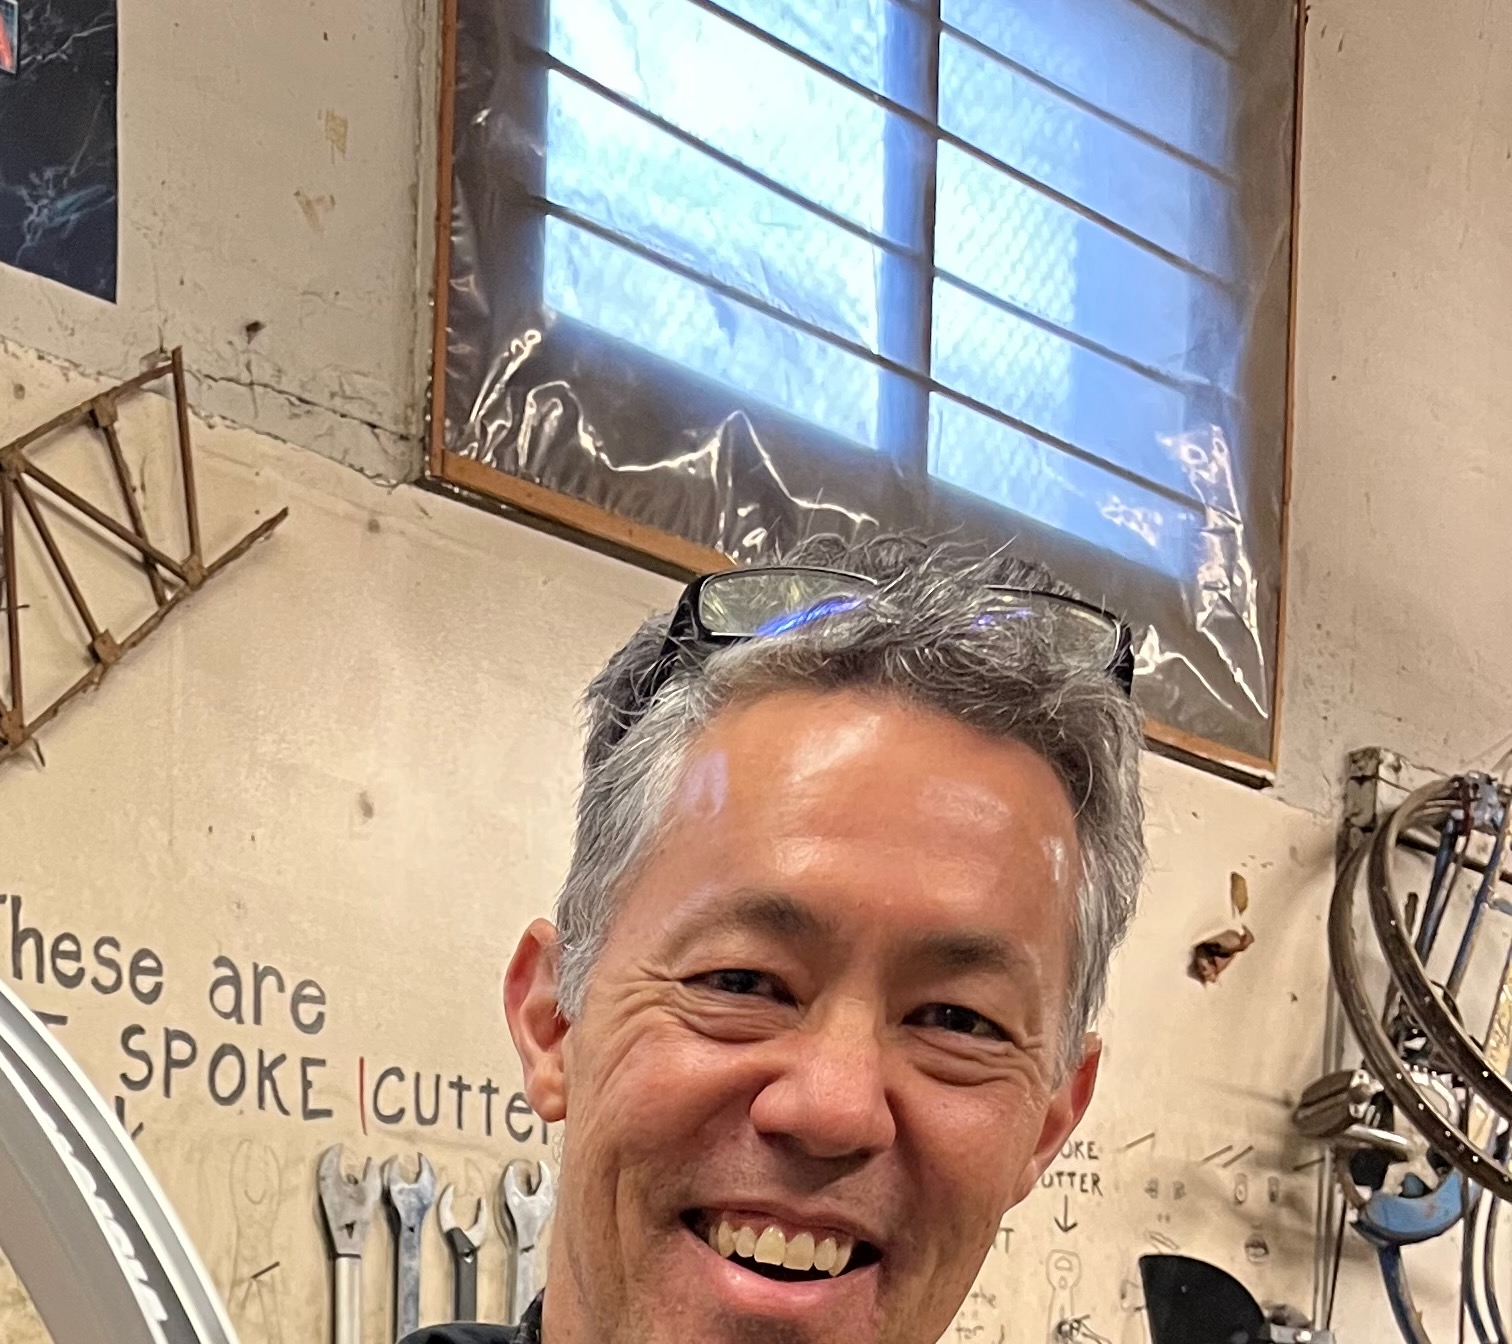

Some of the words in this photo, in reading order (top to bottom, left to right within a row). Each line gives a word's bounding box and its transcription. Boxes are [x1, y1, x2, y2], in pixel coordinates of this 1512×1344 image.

[208, 954, 328, 1035] are
[119, 1023, 334, 1120] SPOKE
[1059, 1141, 1100, 1161] OKE
[1041, 1171, 1104, 1198] UTTER
